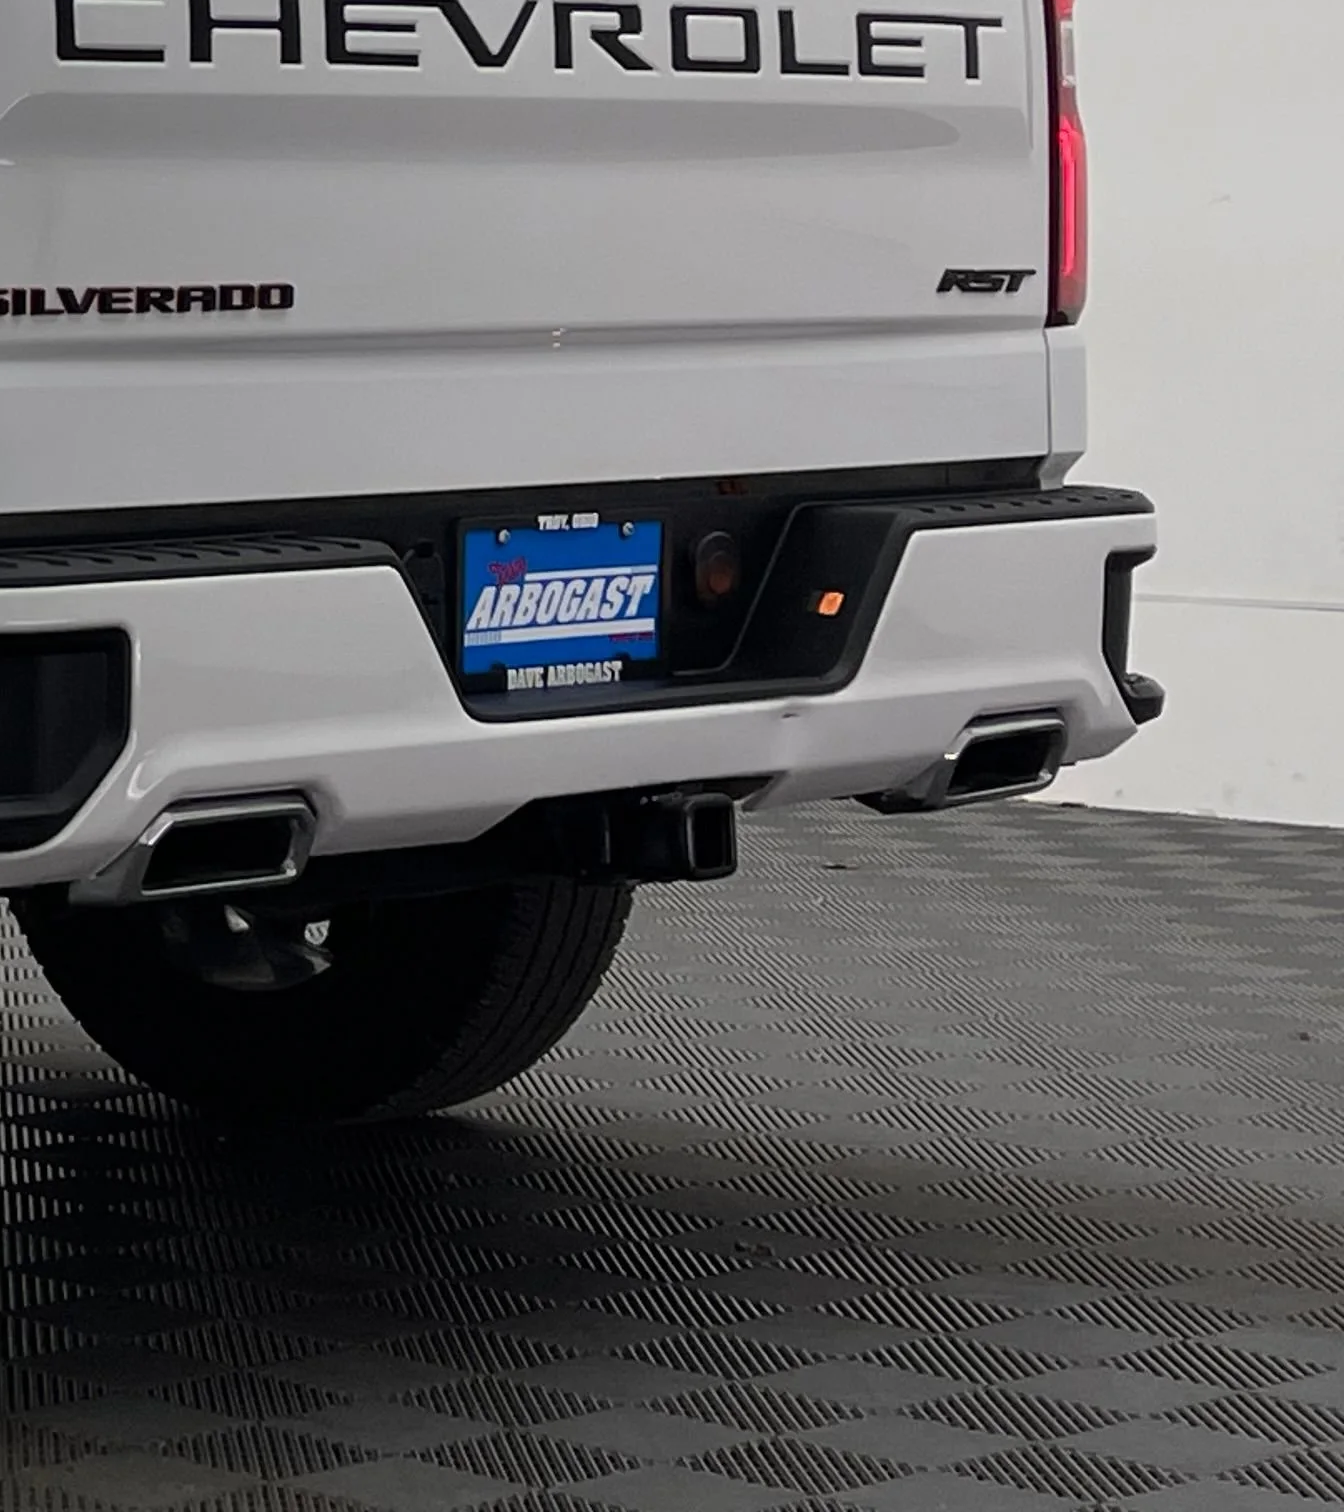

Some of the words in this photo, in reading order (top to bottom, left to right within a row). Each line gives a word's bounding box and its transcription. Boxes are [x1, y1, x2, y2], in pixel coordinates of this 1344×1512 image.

[935, 268, 1038, 294] RST
[465, 574, 655, 631] ARBOGAST
[507, 666, 544, 690] DAVE
[547, 660, 623, 687] ARBOGAST
